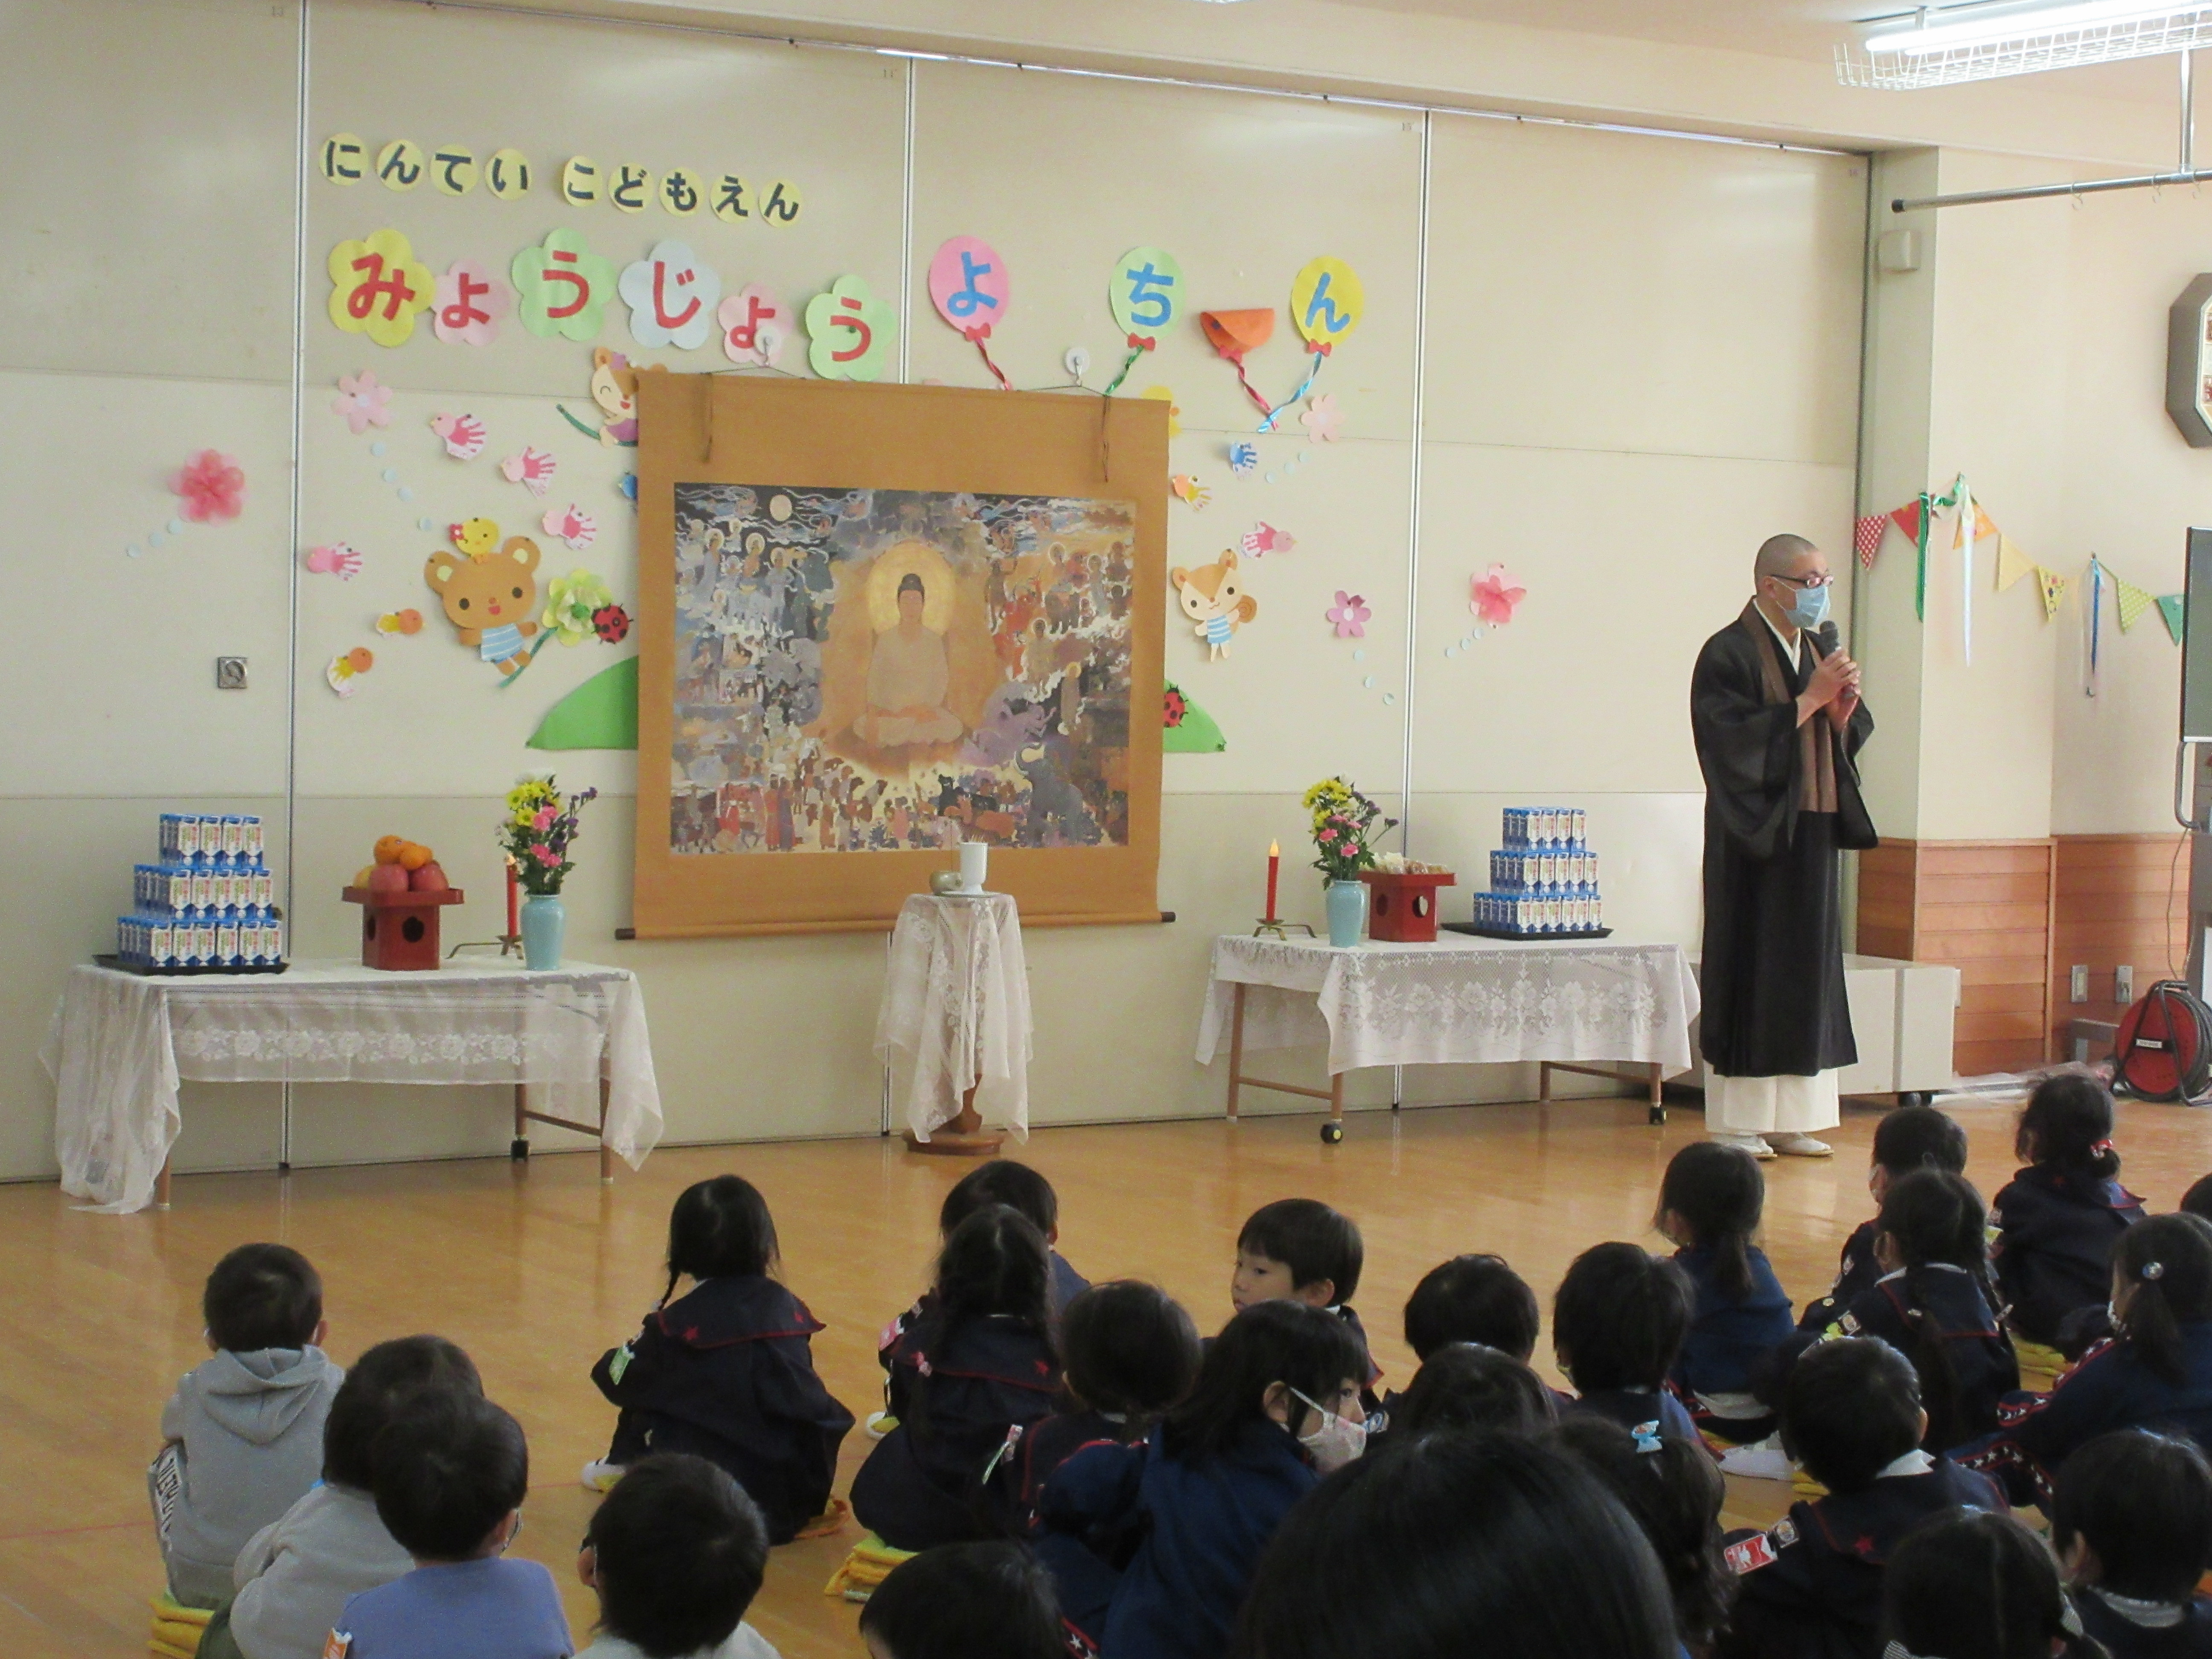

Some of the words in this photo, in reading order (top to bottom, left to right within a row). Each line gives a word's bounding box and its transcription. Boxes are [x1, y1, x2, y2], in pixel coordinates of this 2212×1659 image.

[326, 140, 529, 193] にんてい
[568, 164, 799, 221] こどもえん
[349, 250, 871, 361] みょうじょう
